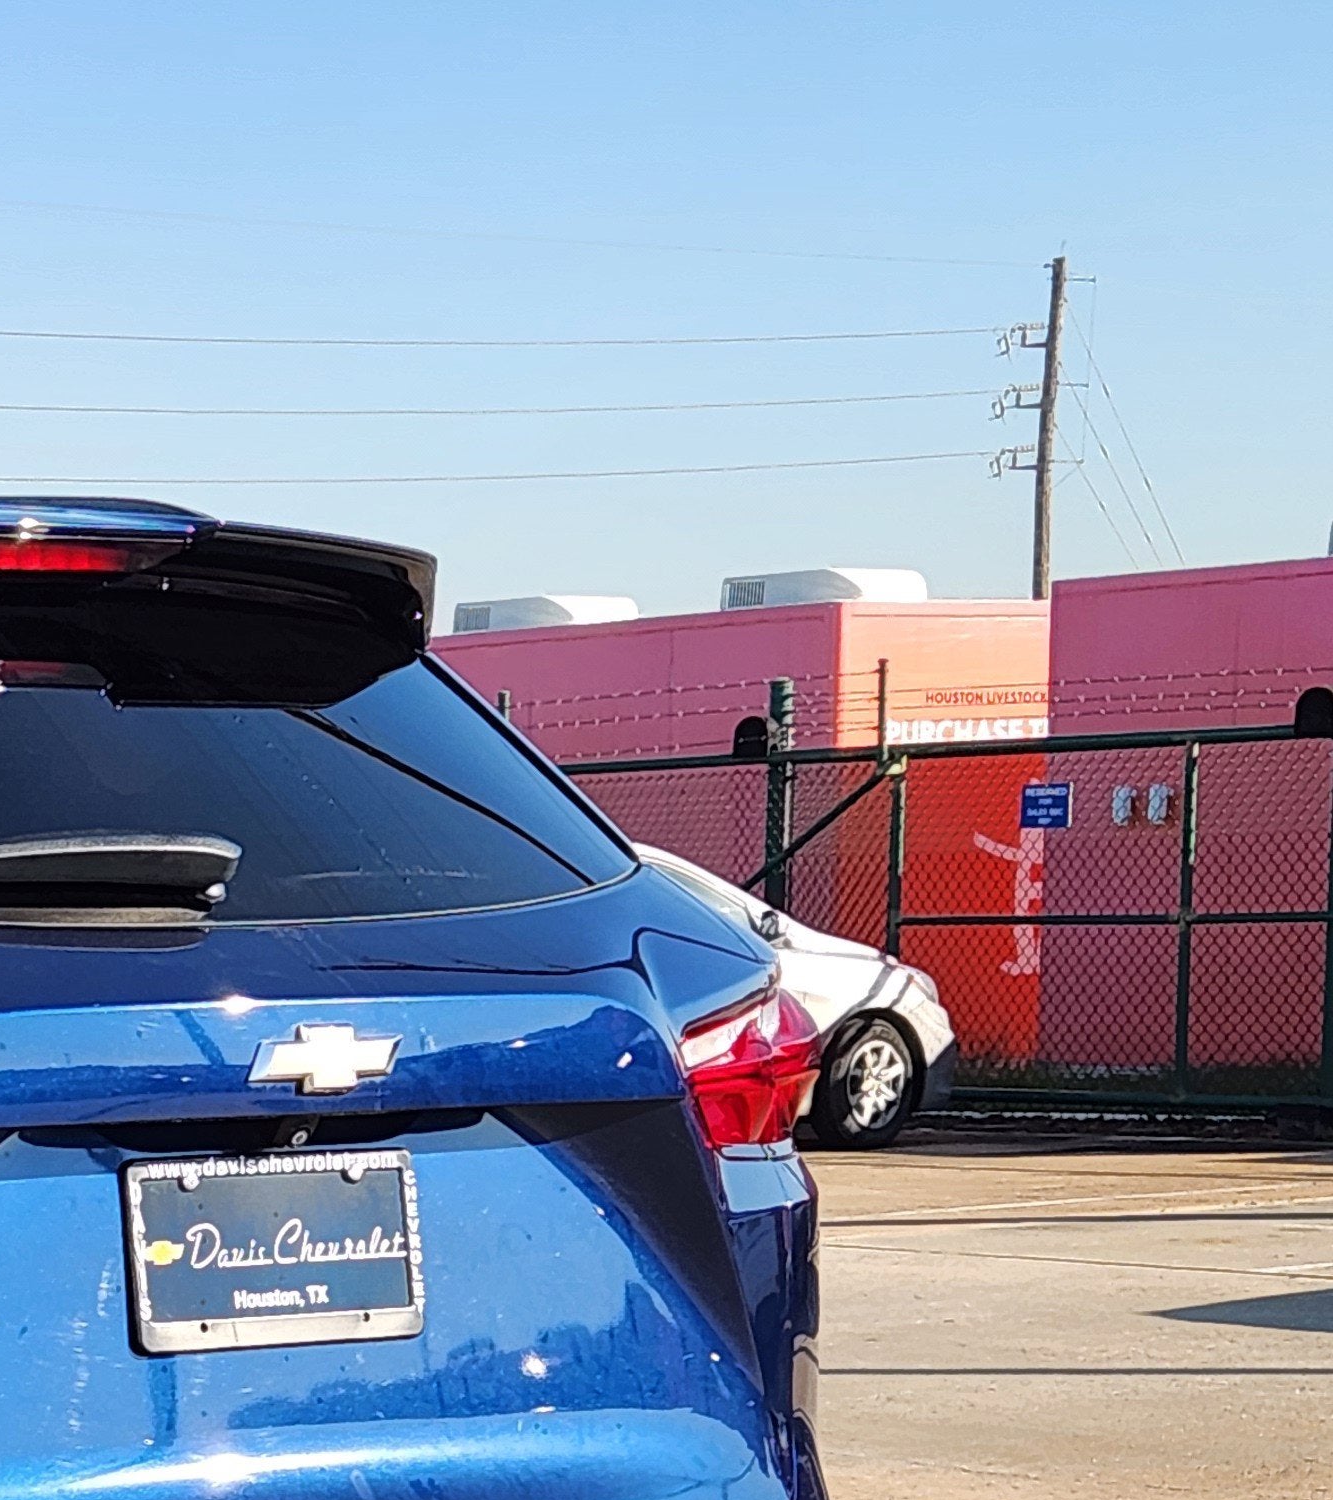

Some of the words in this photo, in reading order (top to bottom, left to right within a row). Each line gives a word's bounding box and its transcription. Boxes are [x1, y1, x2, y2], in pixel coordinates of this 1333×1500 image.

[926, 691, 983, 704] HOUSTON
[986, 690, 1047, 704] LIVESTOCK
[886, 718, 1024, 744] PURCHASE
[185, 1222, 274, 1270] Davis
[274, 1217, 408, 1265] Chevrolet
[233, 1287, 305, 1310] Houston,
[306, 1284, 330, 1304] TX
